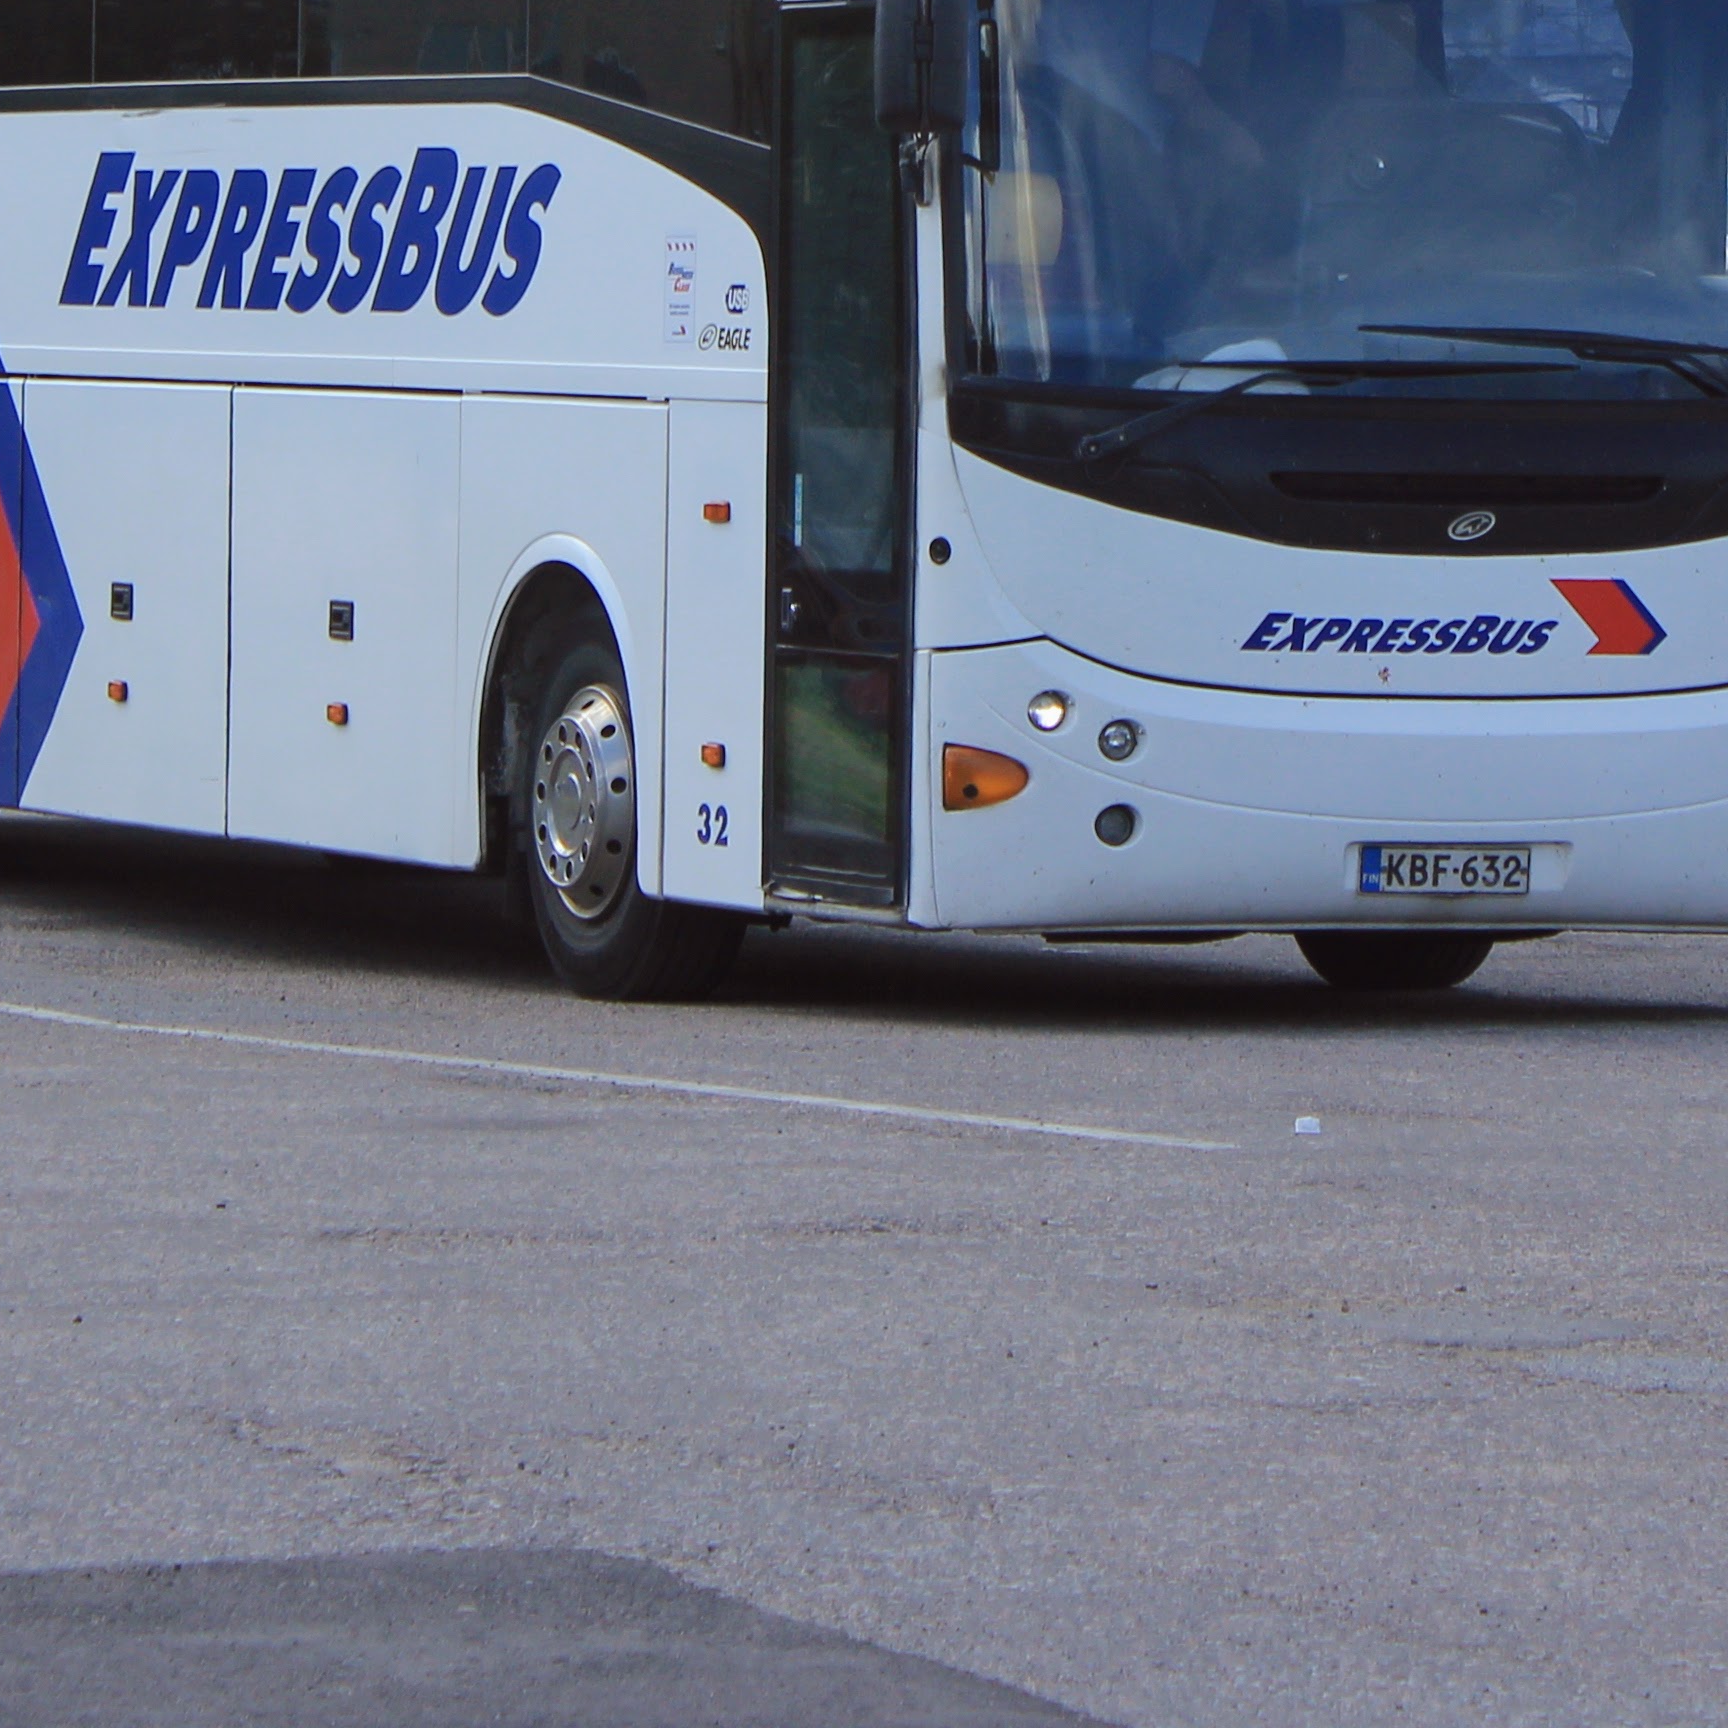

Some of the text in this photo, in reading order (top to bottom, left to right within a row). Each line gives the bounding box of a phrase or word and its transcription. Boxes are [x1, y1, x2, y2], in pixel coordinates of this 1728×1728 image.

[727, 287, 751, 312] USB
[717, 327, 752, 350] EAGLE
[697, 803, 729, 847] 32
[1385, 852, 1522, 889] KBF-632
